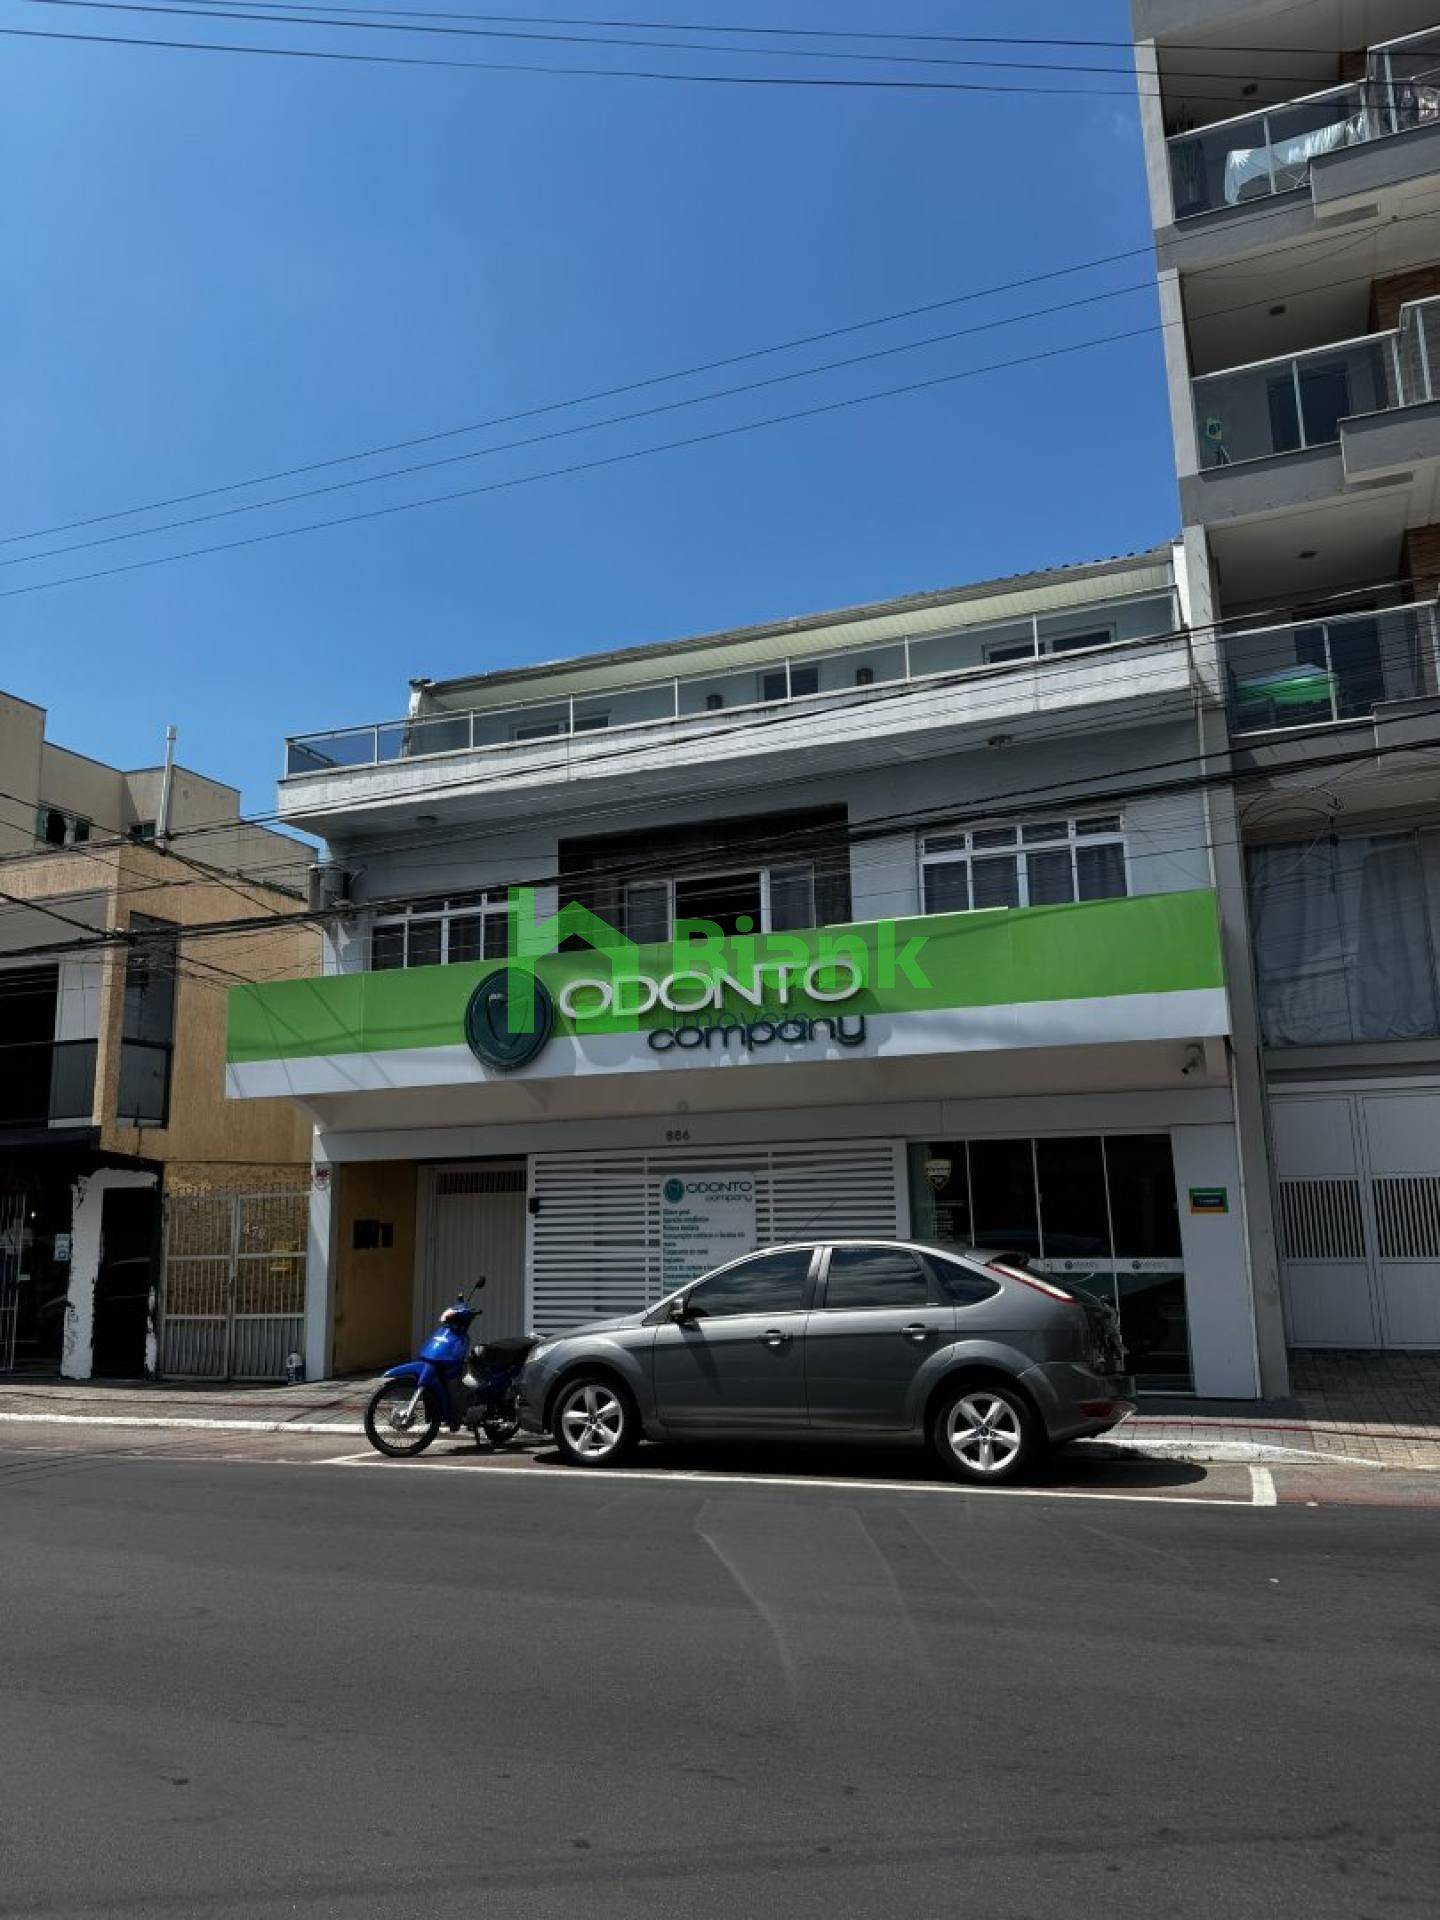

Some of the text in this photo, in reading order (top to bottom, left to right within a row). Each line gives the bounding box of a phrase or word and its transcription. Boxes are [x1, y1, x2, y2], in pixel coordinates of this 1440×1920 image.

[559, 960, 863, 1019] ODONTO
[647, 1013, 867, 1051] company
[685, 1181, 753, 1194] ODONTO
